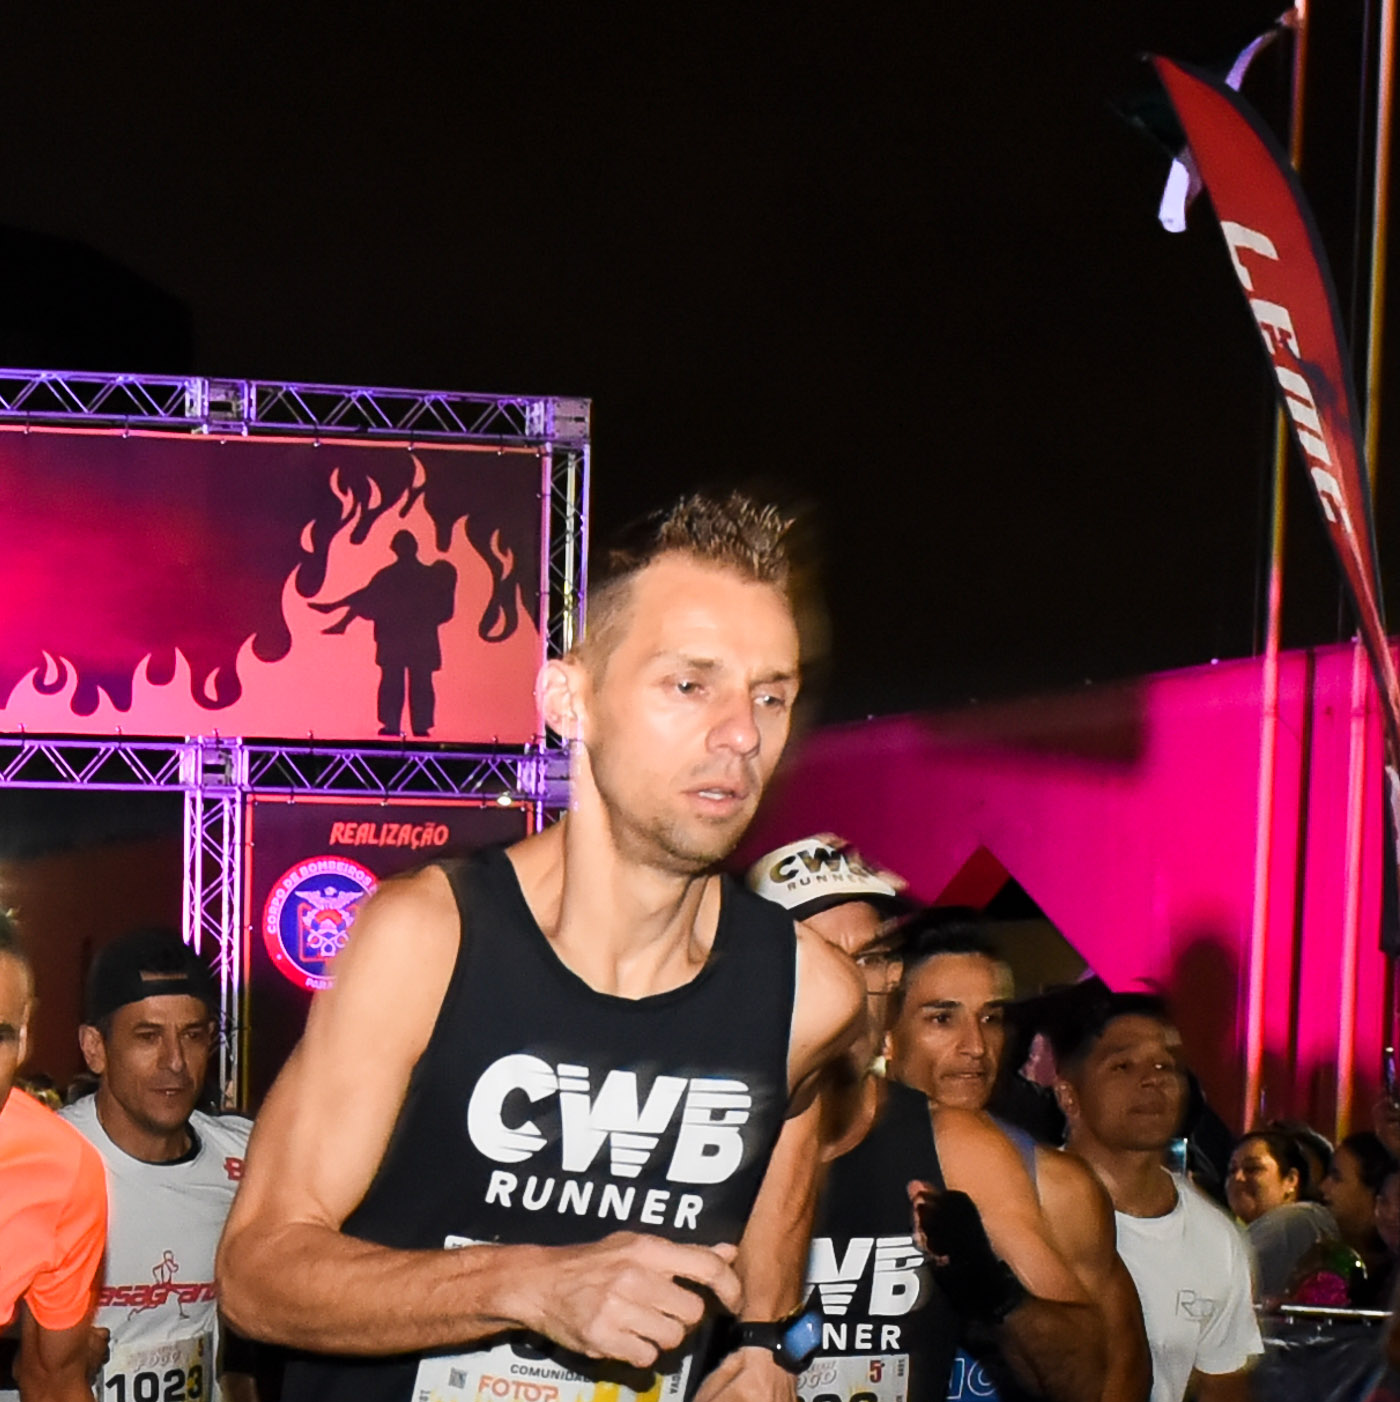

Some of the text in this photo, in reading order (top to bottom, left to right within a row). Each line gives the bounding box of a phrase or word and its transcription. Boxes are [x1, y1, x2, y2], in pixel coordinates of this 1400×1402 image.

[329, 821, 449, 849] REALIZAÇÃO
[467, 1053, 752, 1184] CWB
[485, 1169, 704, 1229] RUNNER
[805, 1236, 924, 1316] WB
[822, 1322, 902, 1351] NER
